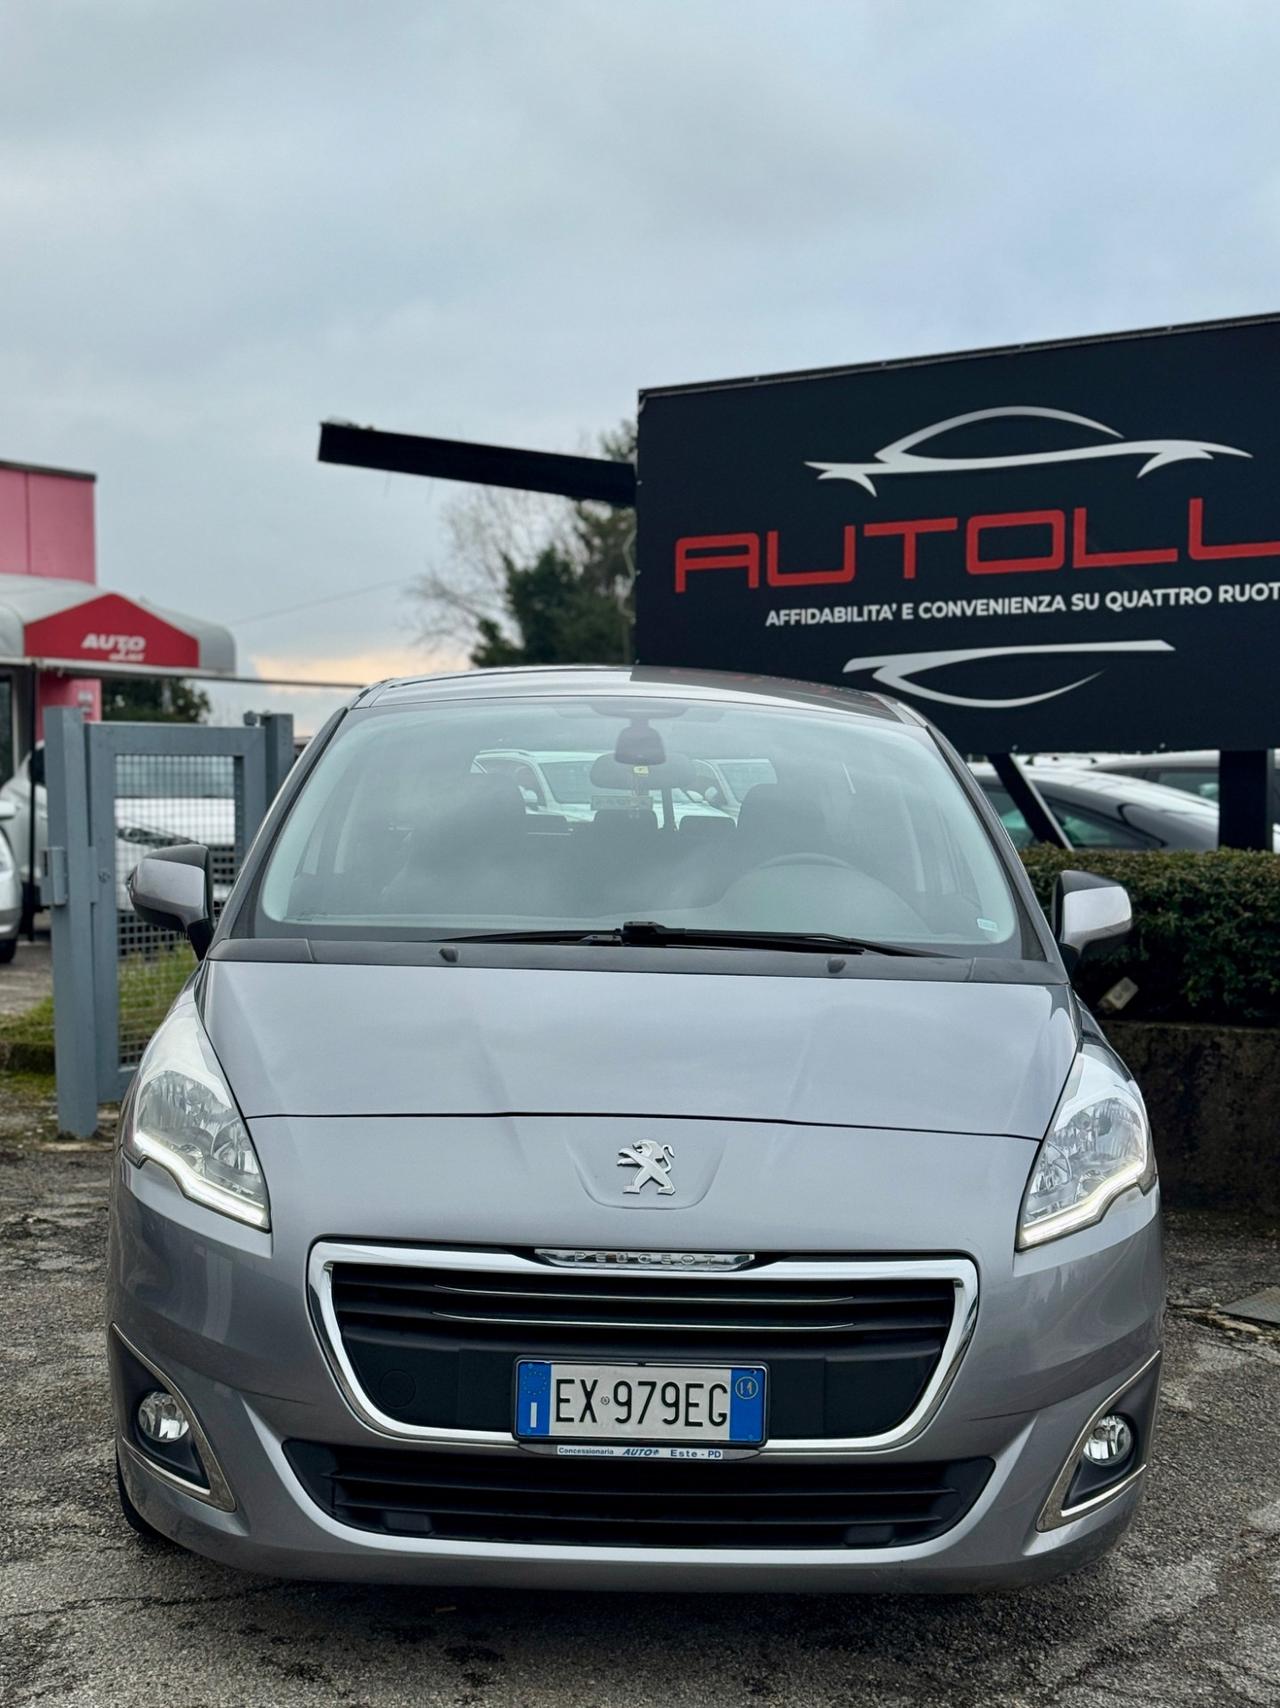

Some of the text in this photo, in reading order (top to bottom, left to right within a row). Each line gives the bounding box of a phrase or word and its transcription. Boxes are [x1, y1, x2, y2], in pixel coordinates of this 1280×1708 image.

[901, 603, 914, 620] E
[918, 595, 1067, 619] CONVENIENZA
[1071, 592, 1099, 611] SU
[1105, 586, 1212, 612] QUATTRO
[80, 633, 146, 651] AUTO
[574, 1251, 716, 1265] PEUGEOT
[558, 1447, 614, 1455] Concessionaria
[670, 1450, 698, 1458] Este
[707, 1450, 722, 1459] PD
